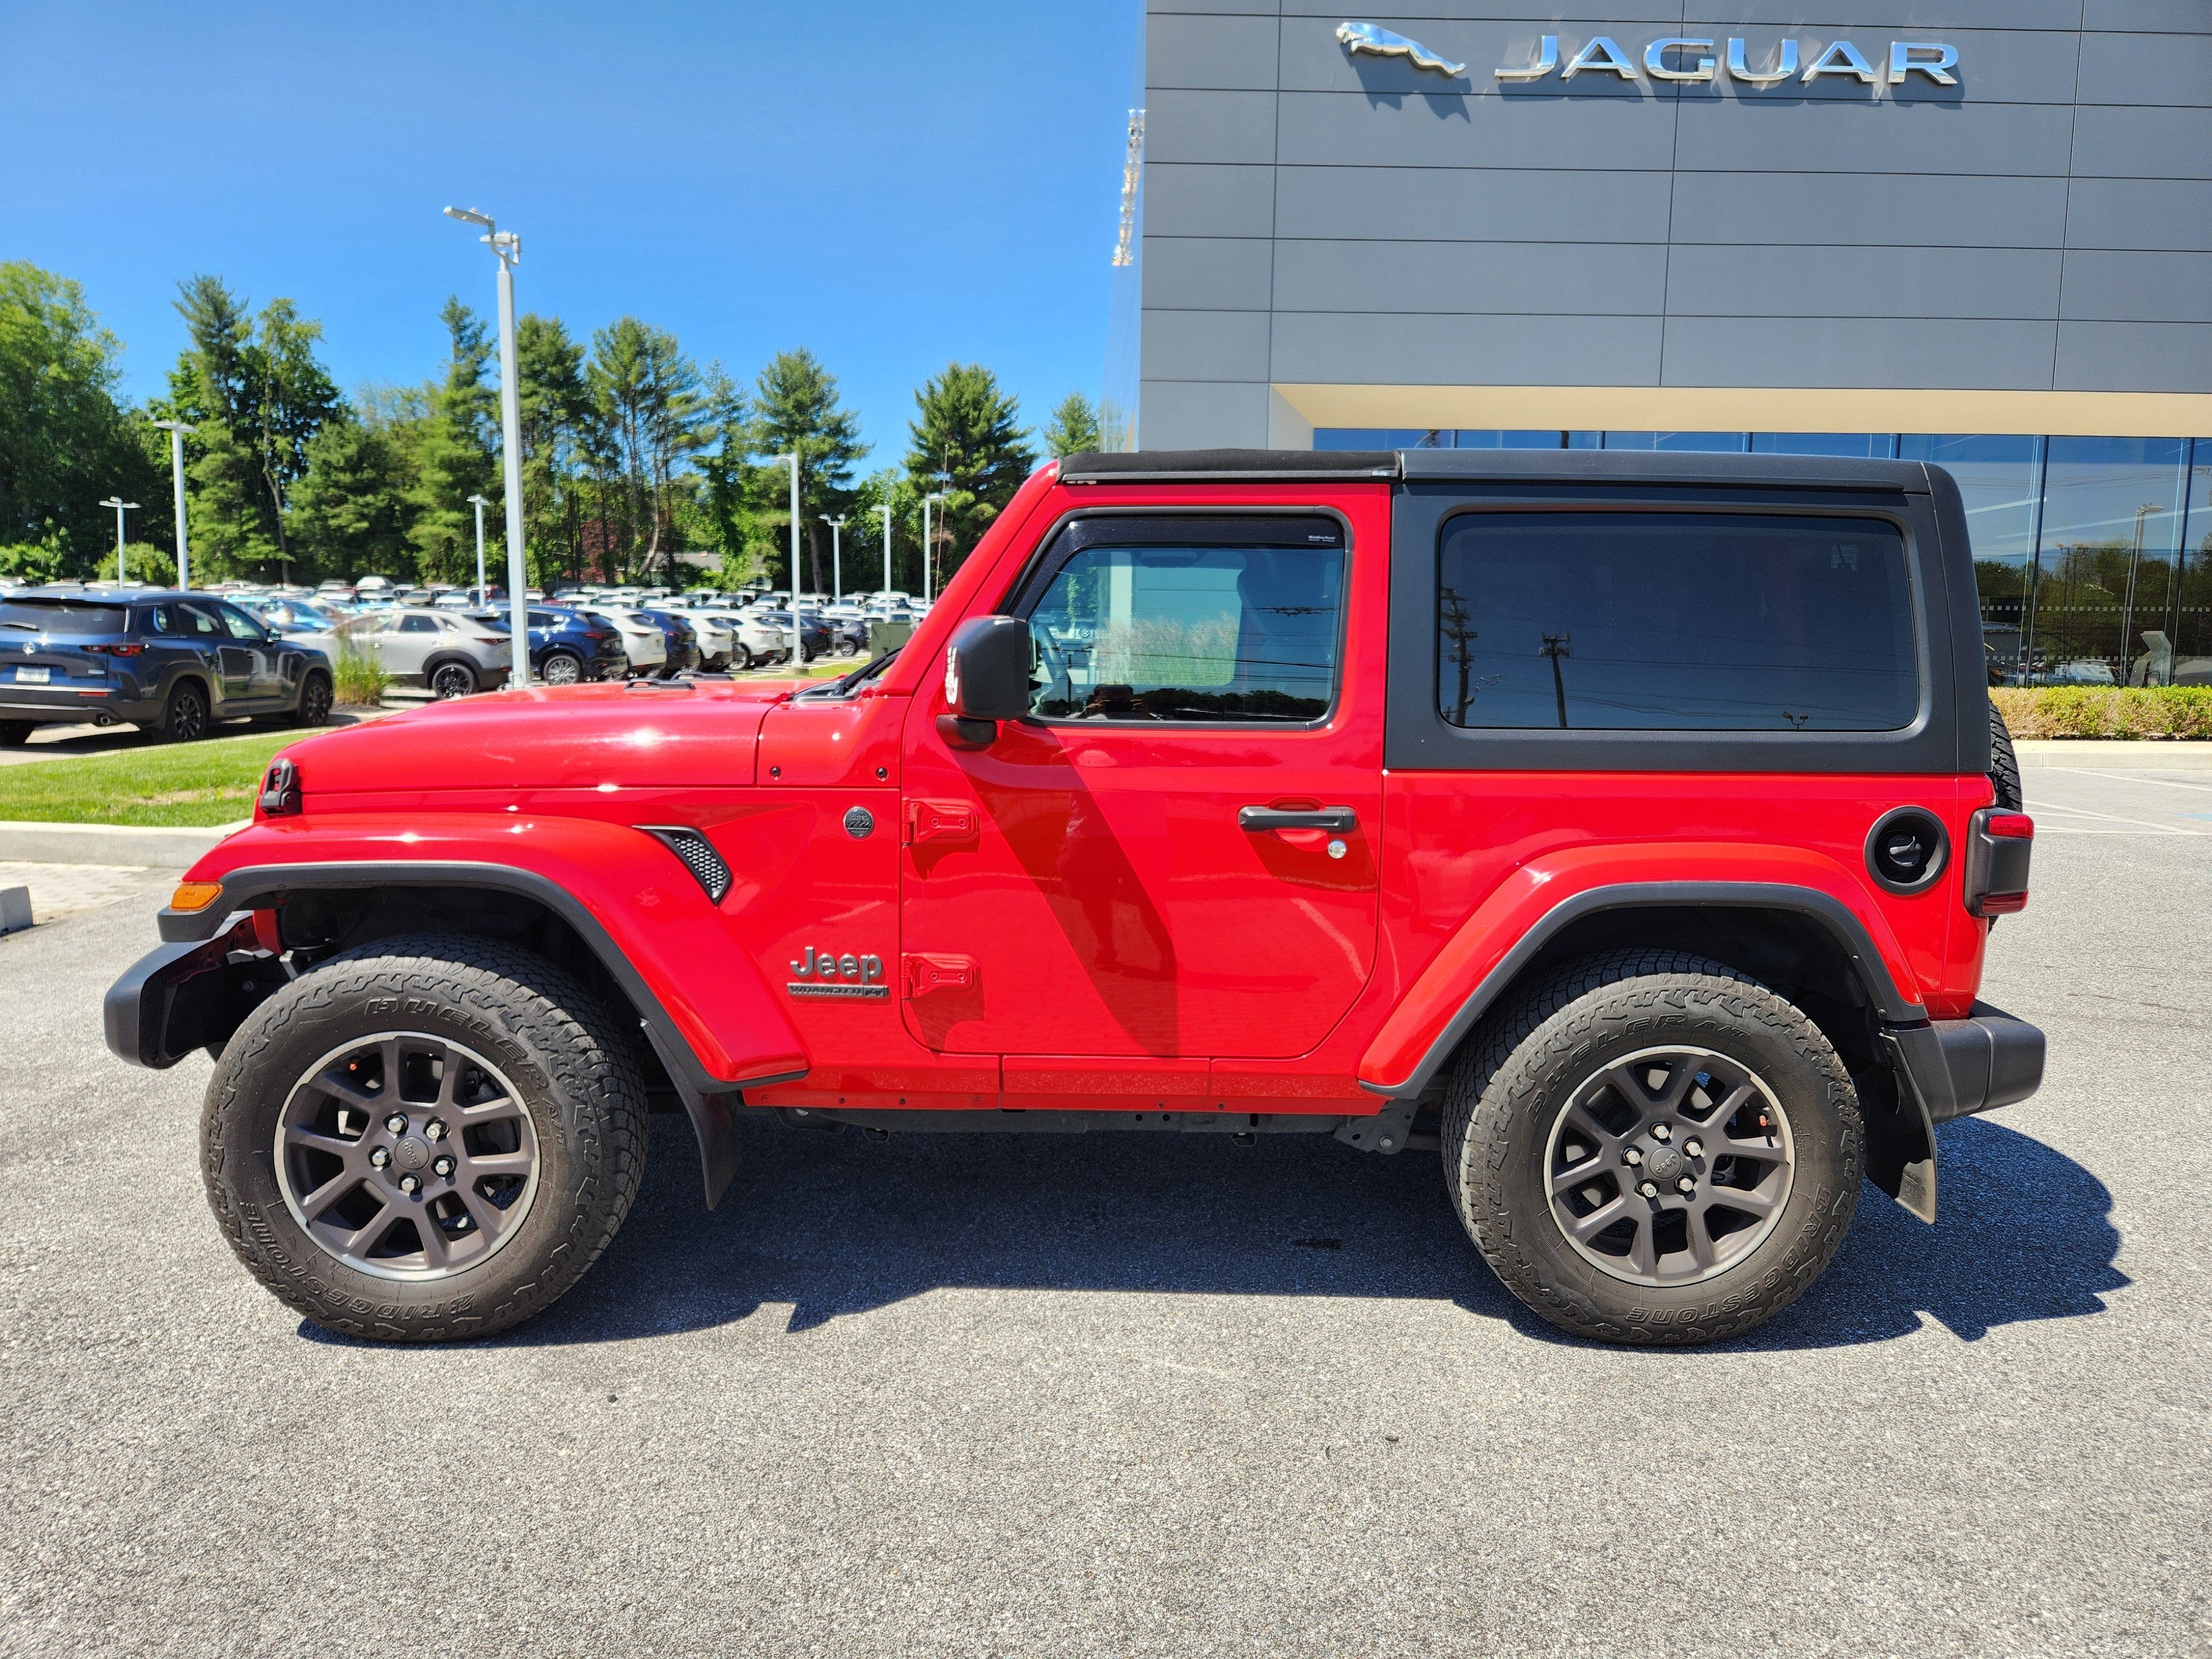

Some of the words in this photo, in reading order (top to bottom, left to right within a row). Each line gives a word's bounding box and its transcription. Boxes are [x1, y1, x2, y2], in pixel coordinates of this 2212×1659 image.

[1494, 35, 1959, 85] JAGUAR
[790, 946, 883, 983] Jeep
[790, 985, 863, 996] WRANGLER
[364, 997, 551, 1089] DUELER
[1524, 1013, 1688, 1124] DUELER
[1694, 1020, 1751, 1039] A/T
[1655, 1154, 1676, 1173] Jeep
[239, 1202, 476, 1321] BRIDGESTONE
[1625, 1183, 1832, 1325] BRIDGESTONE
